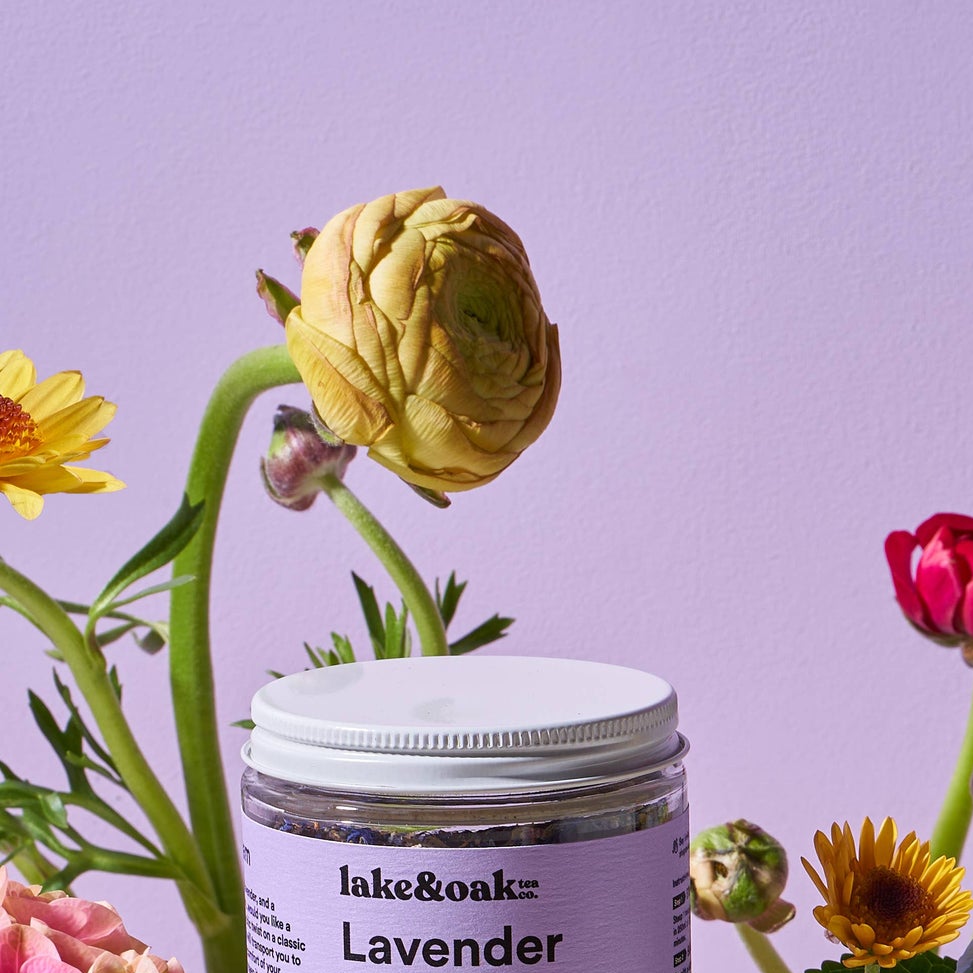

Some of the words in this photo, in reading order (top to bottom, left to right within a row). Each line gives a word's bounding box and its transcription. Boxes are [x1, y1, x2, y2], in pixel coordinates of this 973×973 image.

[339, 864, 518, 901] lake&oak
[518, 878, 539, 889] tea
[518, 890, 538, 900] co.
[271, 902, 275, 911] a
[259, 913, 270, 925] you
[271, 914, 284, 930] like
[285, 923, 291, 932] a
[263, 930, 271, 941] on
[271, 934, 276, 943] a
[277, 934, 306, 952] classic
[343, 921, 563, 967] Lavender
[275, 951, 290, 963] you
[291, 954, 301, 966] to
